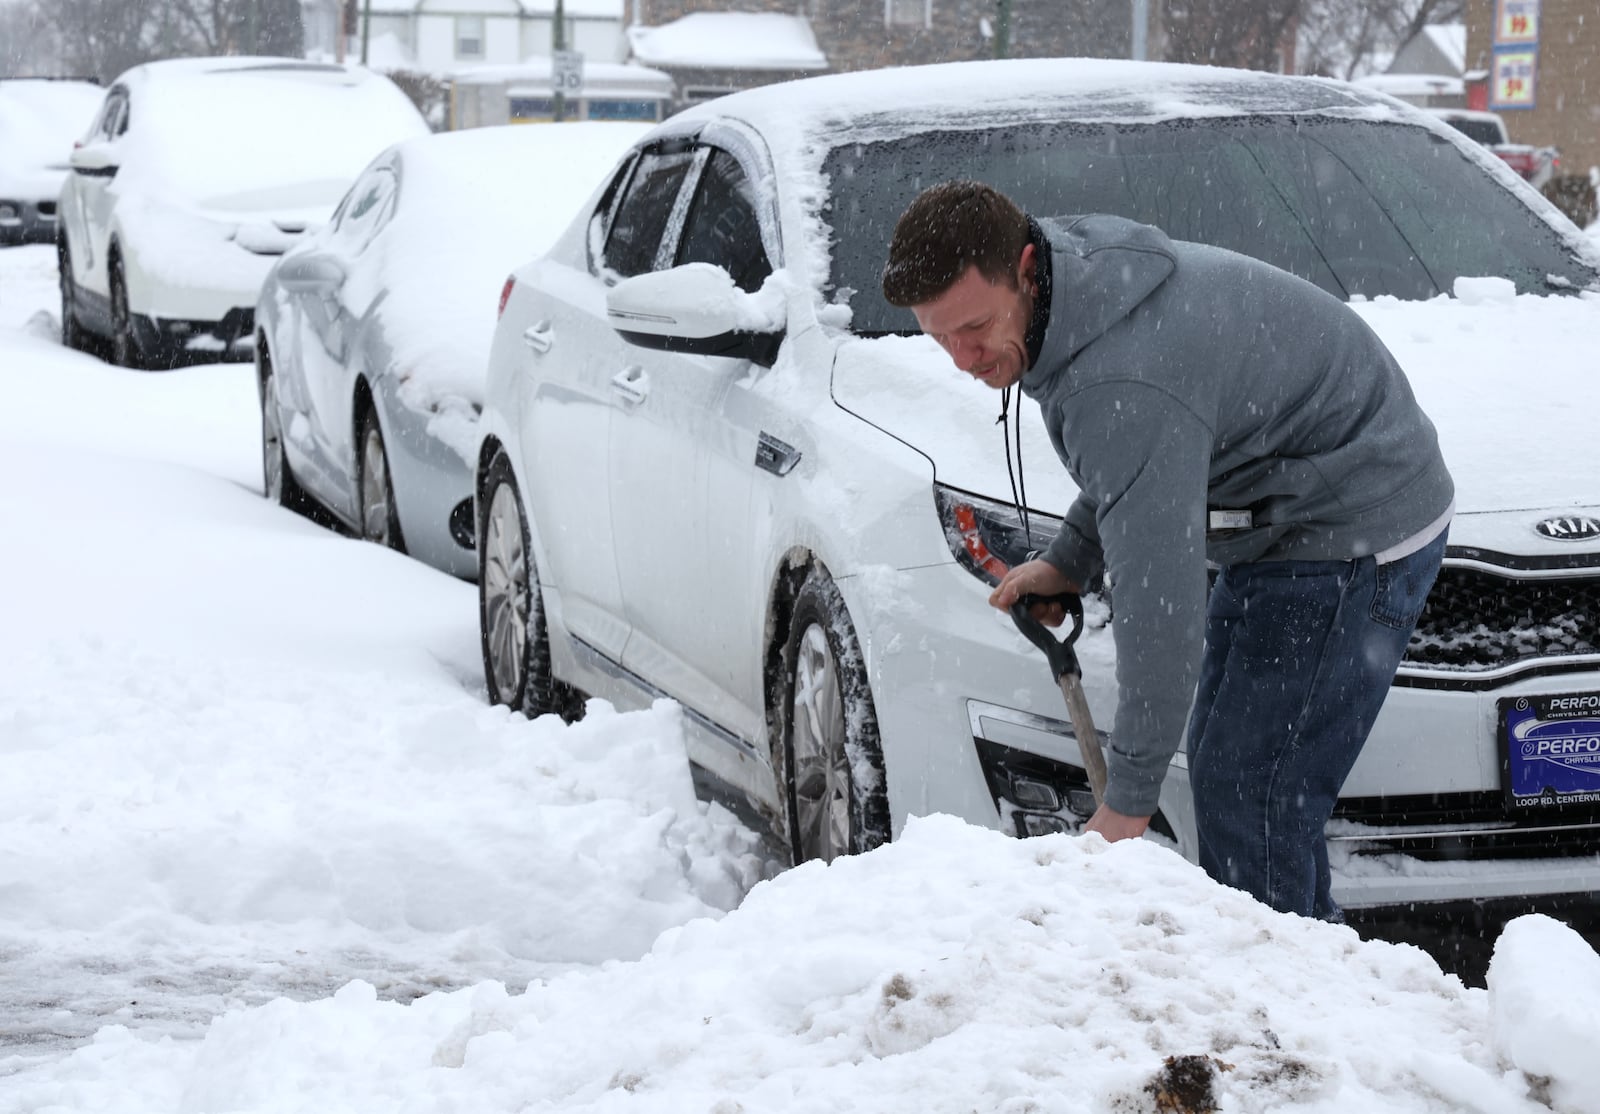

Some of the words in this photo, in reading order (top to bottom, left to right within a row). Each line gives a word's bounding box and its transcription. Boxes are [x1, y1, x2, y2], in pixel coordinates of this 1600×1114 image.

[1544, 518, 1600, 535] KIA
[1550, 696, 1600, 711] PERFO
[1547, 711, 1588, 719] CHRYSLER
[1515, 798, 1539, 807] LOOP
[1540, 797, 1555, 806] RD.
